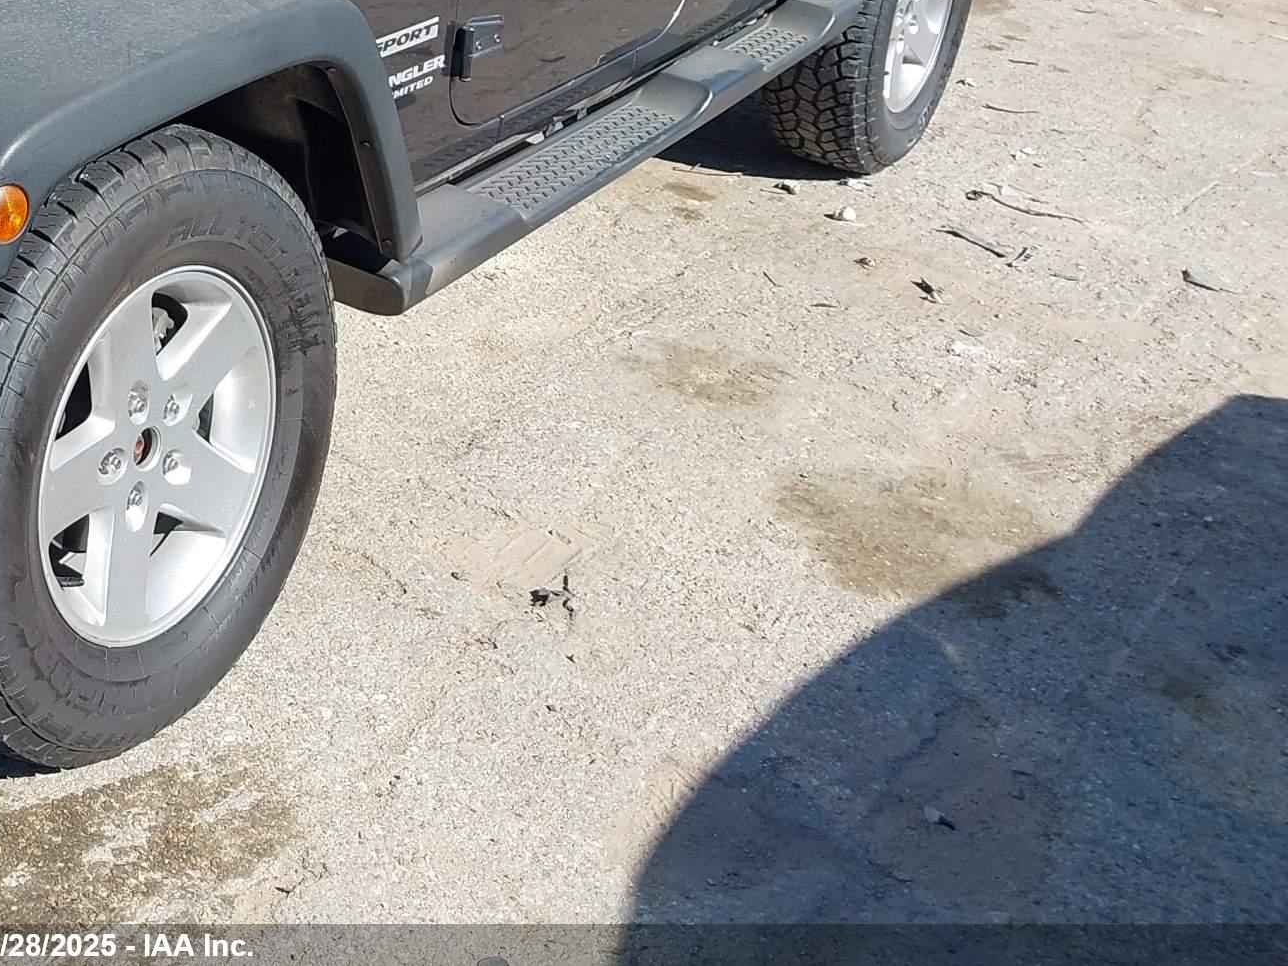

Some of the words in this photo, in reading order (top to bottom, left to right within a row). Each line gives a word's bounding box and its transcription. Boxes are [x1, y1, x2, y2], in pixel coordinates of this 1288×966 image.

[376, 25, 432, 52] PORT
[389, 54, 446, 87] NGLER
[392, 76, 434, 99] MITED
